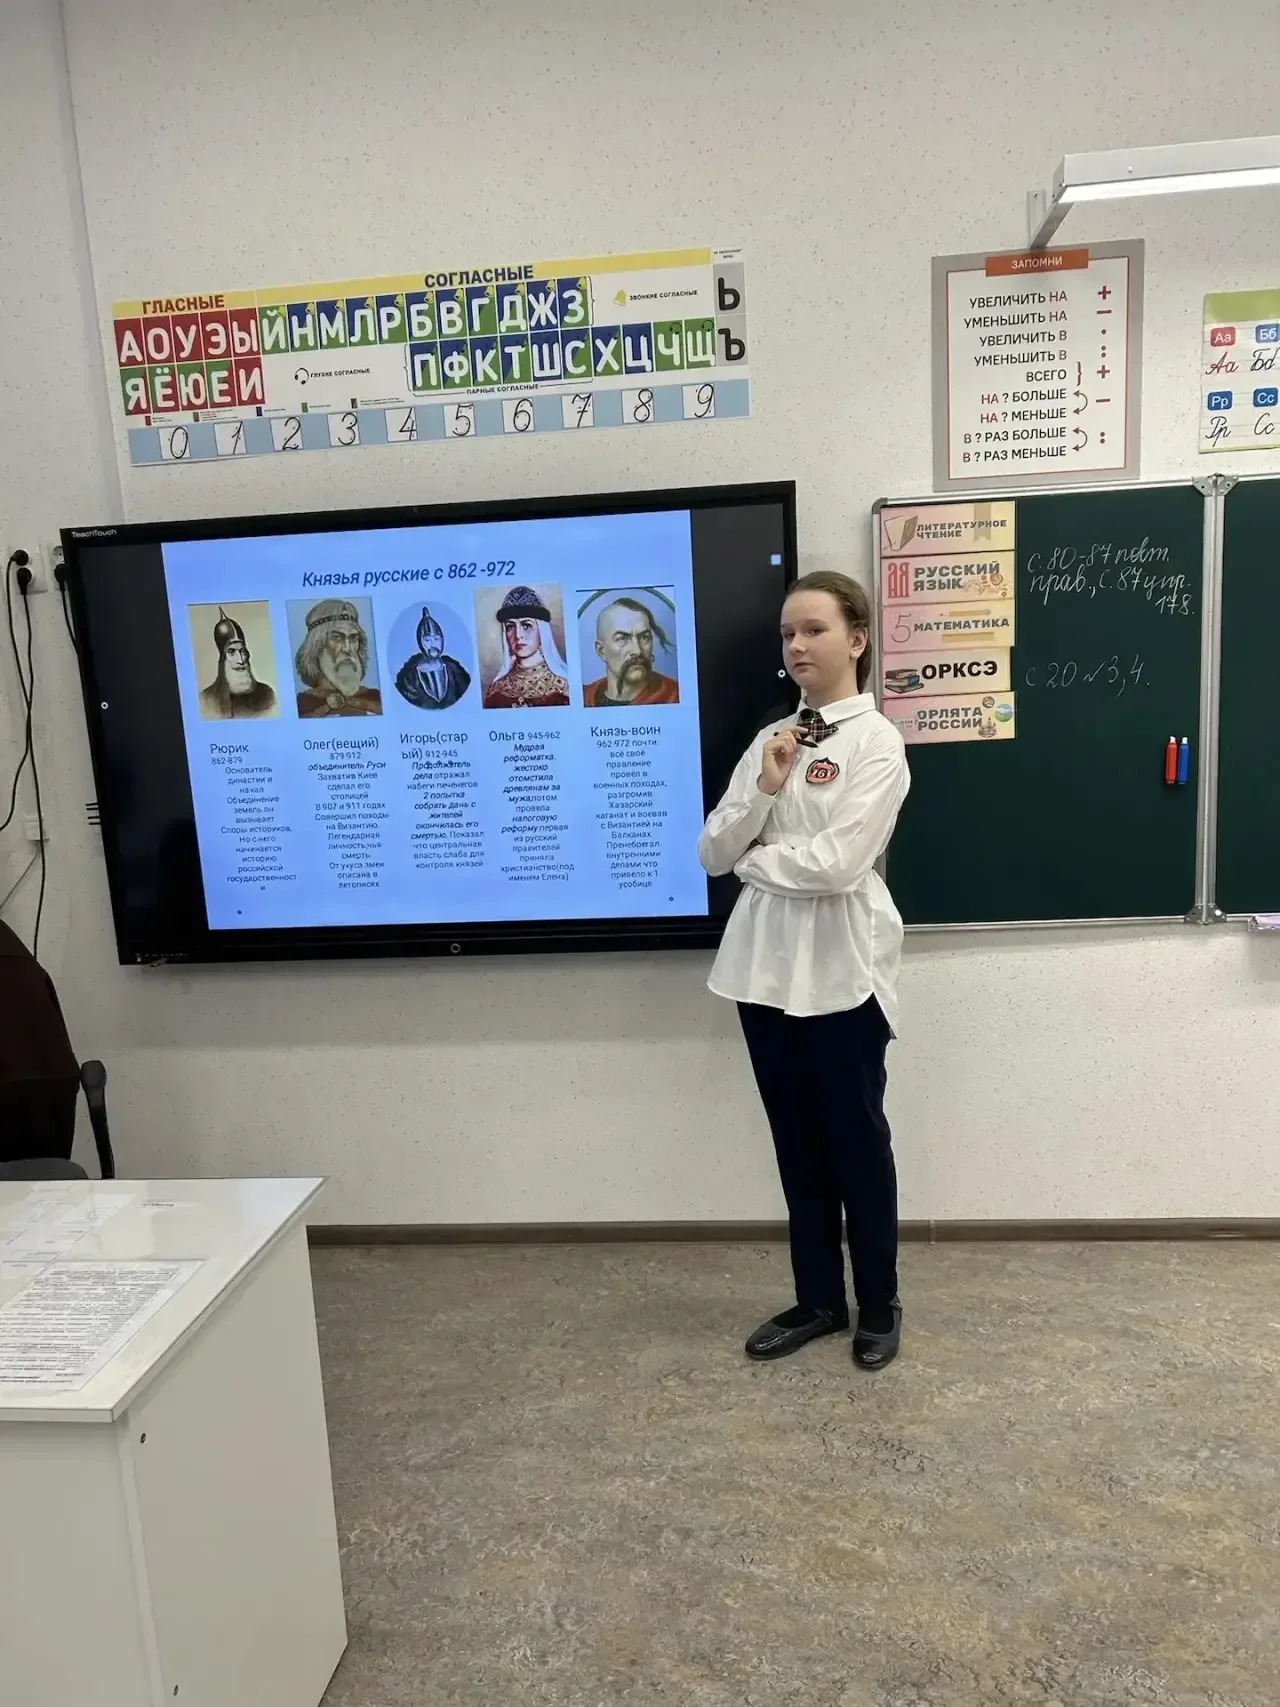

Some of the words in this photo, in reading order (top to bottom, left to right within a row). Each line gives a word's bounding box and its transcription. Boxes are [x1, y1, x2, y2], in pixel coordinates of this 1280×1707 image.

[1012, 257, 1063, 269] ЗАПОМНИ
[424, 266, 534, 288] СОГЛАСНЫЕ
[629, 292, 657, 301] ЗВОНКИЕ
[659, 289, 698, 300] СОГЛАСНЫЕ
[718, 277, 740, 311] Ь
[970, 292, 1046, 309] УВЕЛИЧИТЬ
[1049, 291, 1067, 303] НА
[142, 295, 225, 315] ГЛАСНЫЕ
[964, 312, 1046, 329] УМЕНЬШИТЬ
[1049, 310, 1067, 323] НА
[979, 332, 1056, 348] УВЕЛИЧИТЬ
[1060, 330, 1067, 341] В
[1214, 332, 1232, 344] Аа
[1260, 328, 1277, 340] Бб
[718, 328, 746, 361] Ъ
[974, 351, 1056, 368] УМЕНЬШИТЬ
[1060, 350, 1067, 361] В
[1205, 351, 1238, 375] Аа
[335, 368, 371, 377] СОГЛАСНЫЕ
[1026, 369, 1067, 383] ВСЕГО
[466, 386, 495, 395] ПАРНЫЕ
[497, 384, 539, 393] СОГЛАСНЫЕ
[981, 394, 999, 406] НА
[1012, 388, 1067, 403] БОЛЬШЕ
[1212, 396, 1229, 409] Рр
[1257, 392, 1275, 404] Сс
[169, 426, 188, 459] 0
[231, 421, 243, 455] 1
[282, 417, 301, 451] 2
[337, 412, 358, 446] 3
[399, 407, 417, 441] 4
[453, 404, 475, 437] 5
[513, 398, 533, 432] 6
[572, 393, 592, 428] 7
[634, 388, 654, 422] 8
[695, 384, 715, 419] 9
[980, 412, 998, 424] НА
[1012, 407, 1067, 421] МЕНЬШЕ
[1254, 412, 1275, 436] Сс
[964, 434, 972, 444] В
[985, 430, 1009, 443] РАЗ
[1012, 427, 1067, 441] БОЛЬШЕ
[963, 452, 971, 463] В
[984, 449, 1009, 462] РАЗ
[1011, 446, 1067, 460] МЕНЬШЕ
[917, 520, 1007, 532] ЛИТЕРАТУРНОЕ
[71, 529, 117, 539] TeachTouch
[917, 530, 962, 539] ЧТЕНИЕ
[302, 571, 359, 587] Князья
[364, 568, 430, 588] русские
[434, 568, 444, 580] с
[449, 562, 477, 579] 862
[914, 560, 1000, 579] РУССКИЙ
[914, 578, 963, 592] ЯЗЫК
[914, 618, 1010, 632] МАТЕМАТИКА
[922, 660, 998, 680] ОРКСЭ
[918, 707, 983, 720] ОРЛЯТА
[591, 726, 661, 737] Князь-воин
[918, 718, 983, 731] РОССИИ
[400, 731, 468, 746] Игорь(стар
[489, 731, 525, 742] Ольга
[210, 743, 250, 756] Рюрик
[303, 736, 380, 752] Олег(вещий)
[514, 744, 545, 753] Мудрая
[225, 766, 273, 774] Основатель
